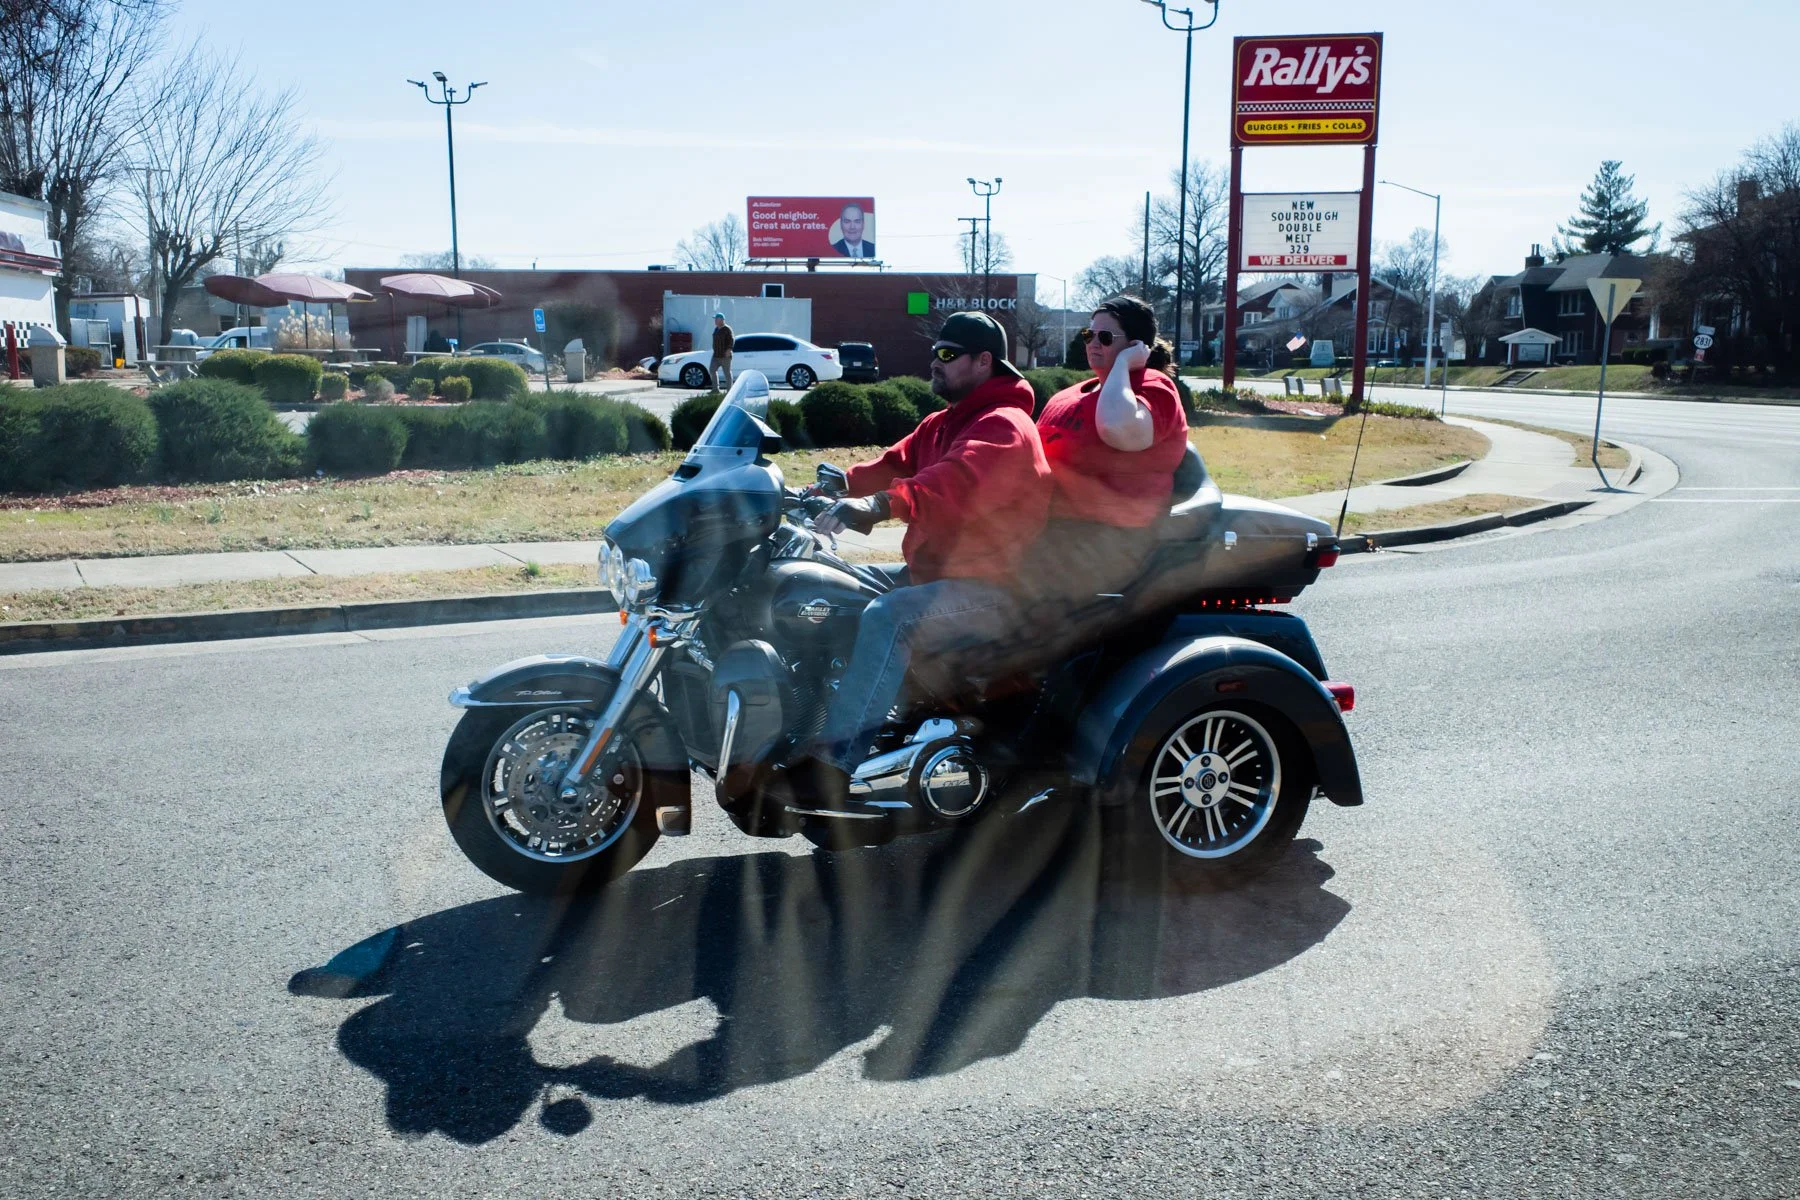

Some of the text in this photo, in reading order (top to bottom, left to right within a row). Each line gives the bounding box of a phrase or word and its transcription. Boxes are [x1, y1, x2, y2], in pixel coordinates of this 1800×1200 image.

[1243, 46, 1372, 93] Rally's
[1247, 123, 1288, 131] BURGERS
[1298, 122, 1321, 130] FRIES
[1292, 201, 1314, 210] NEW
[752, 211, 820, 221] Good neighbor.
[1272, 211, 1338, 221] SOURDOUGH
[752, 221, 828, 230] Great auto rates.
[1279, 223, 1321, 232] DOUBLE
[1286, 234, 1311, 243] MELT
[1290, 245, 1309, 254] 329
[1260, 255, 1335, 265] WE DELIVER
[971, 298, 1017, 309] BLOCK
